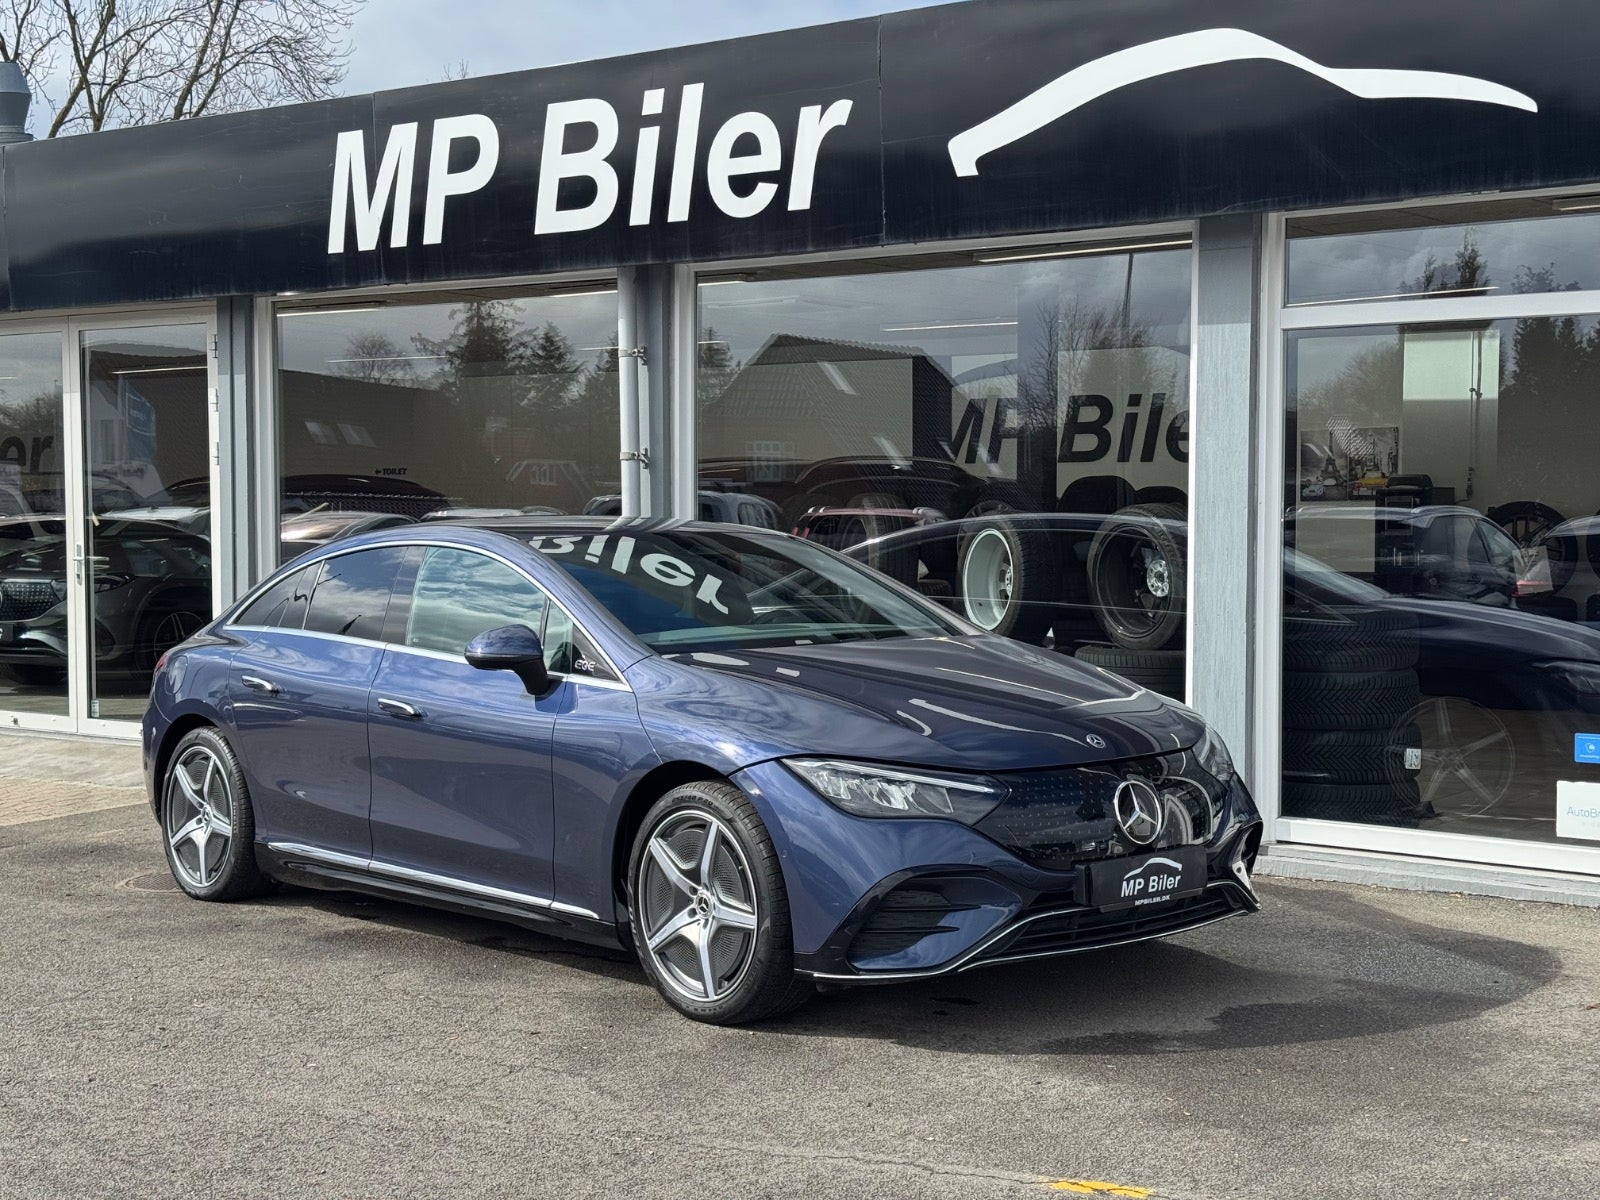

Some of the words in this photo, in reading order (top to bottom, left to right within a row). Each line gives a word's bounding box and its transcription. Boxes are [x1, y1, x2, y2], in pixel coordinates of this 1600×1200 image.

[328, 114, 499, 254] MP
[534, 82, 853, 235] Biler
[382, 467, 407, 476] TOILET
[574, 659, 595, 672] EQE
[1120, 878, 1144, 898] MP
[1148, 873, 1181, 893] Biler
[1135, 895, 1170, 906] MPBILER.DK
